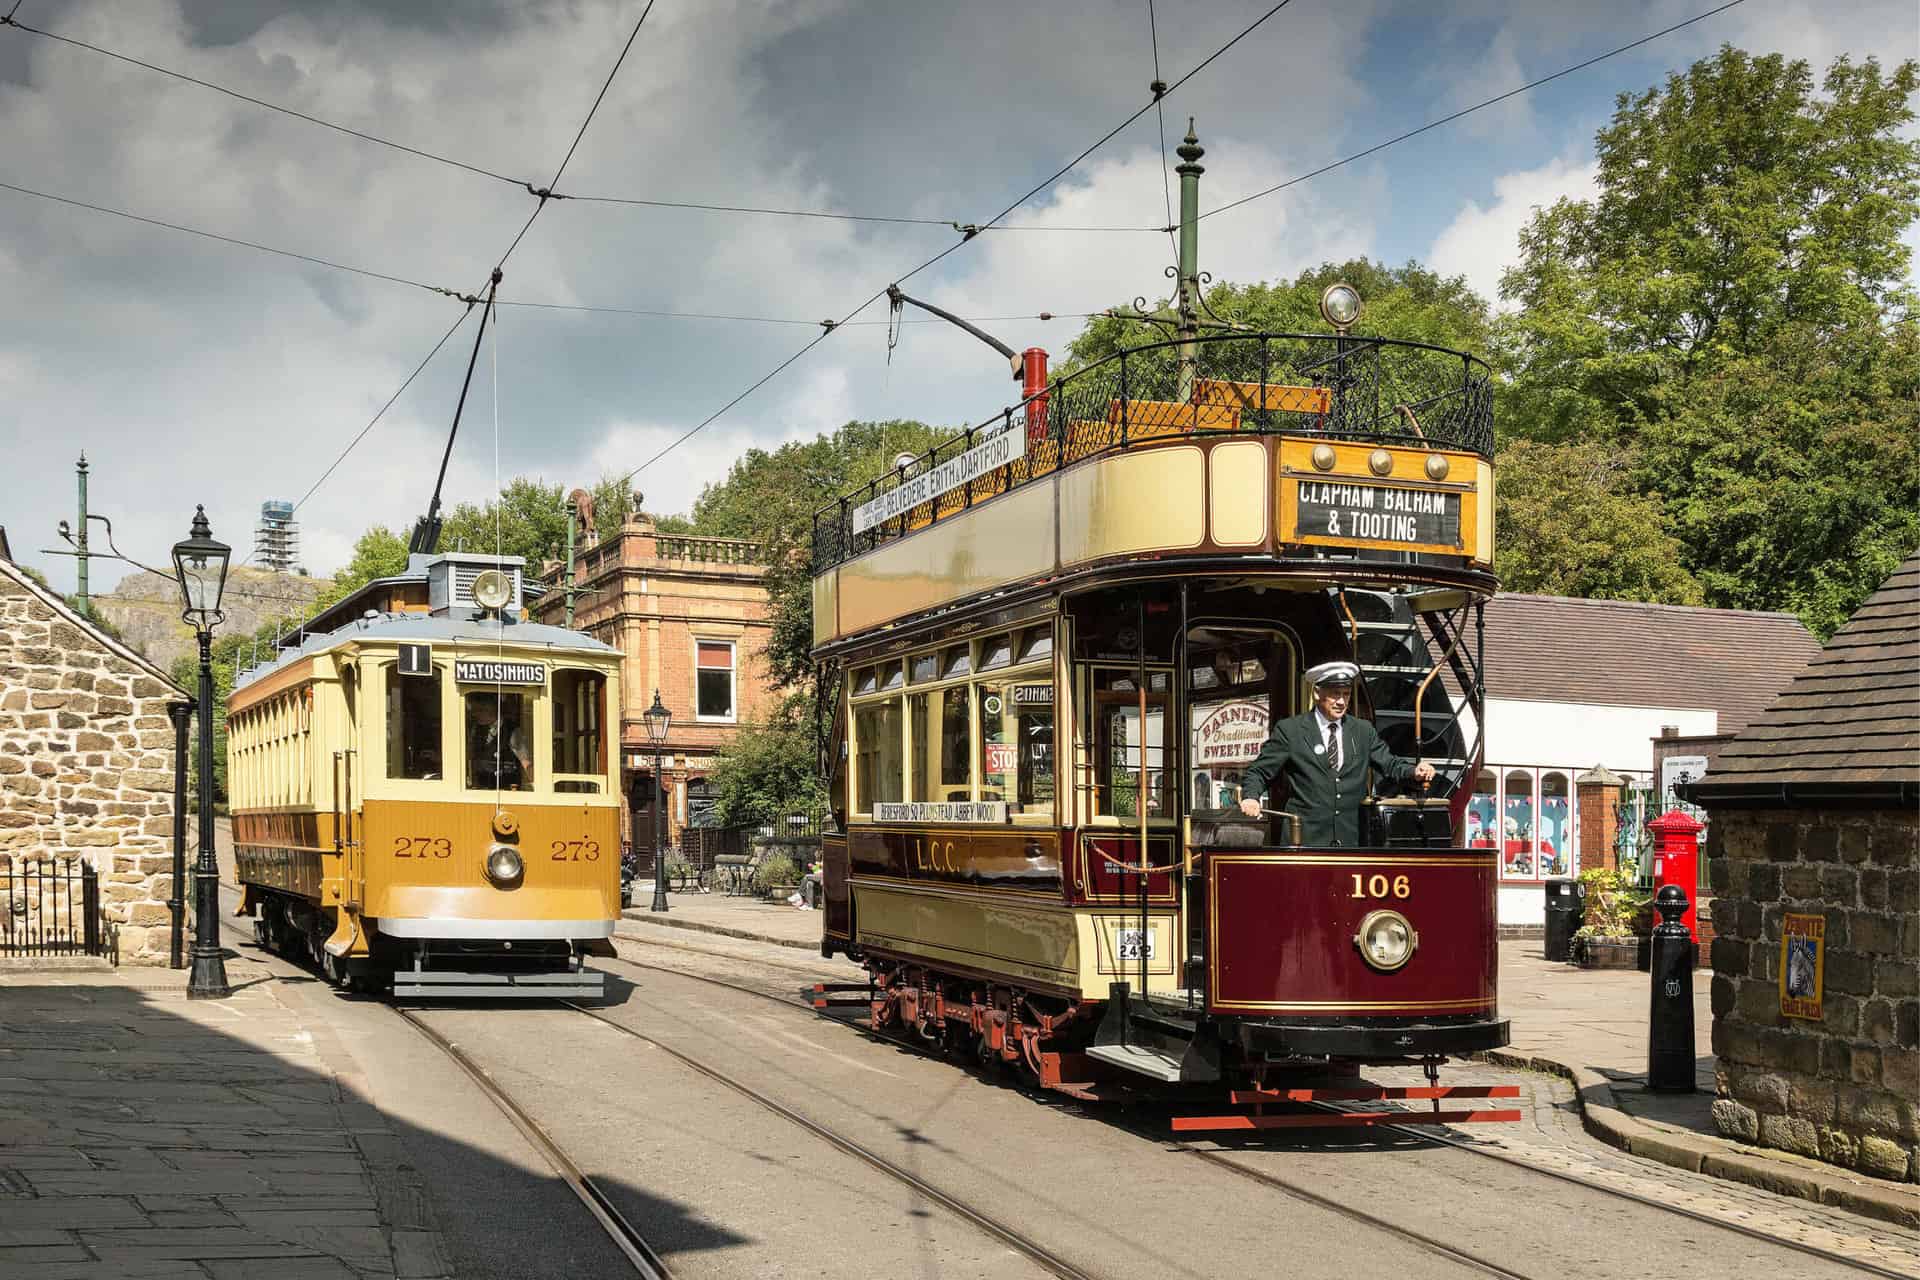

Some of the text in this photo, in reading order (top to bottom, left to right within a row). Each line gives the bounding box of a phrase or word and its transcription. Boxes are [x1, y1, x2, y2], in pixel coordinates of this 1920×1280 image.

[886, 477, 926, 515] BELVEDERE
[930, 462, 955, 494] ERITH
[960, 436, 1010, 477] DARTFORD
[1300, 482, 1445, 515] CLAPHAM BALHAM
[1327, 509, 1417, 541] & TOOTING
[456, 663, 544, 682] MATOSINHOS
[1213, 728, 1265, 743] Traditional
[1203, 744, 1241, 758] SWEET
[880, 804, 909, 821] BERESFORD
[955, 804, 975, 821] ABBEY
[975, 804, 996, 821] WOOD
[394, 837, 452, 859] 273
[551, 841, 600, 861] 273
[1351, 874, 1411, 898] 106
